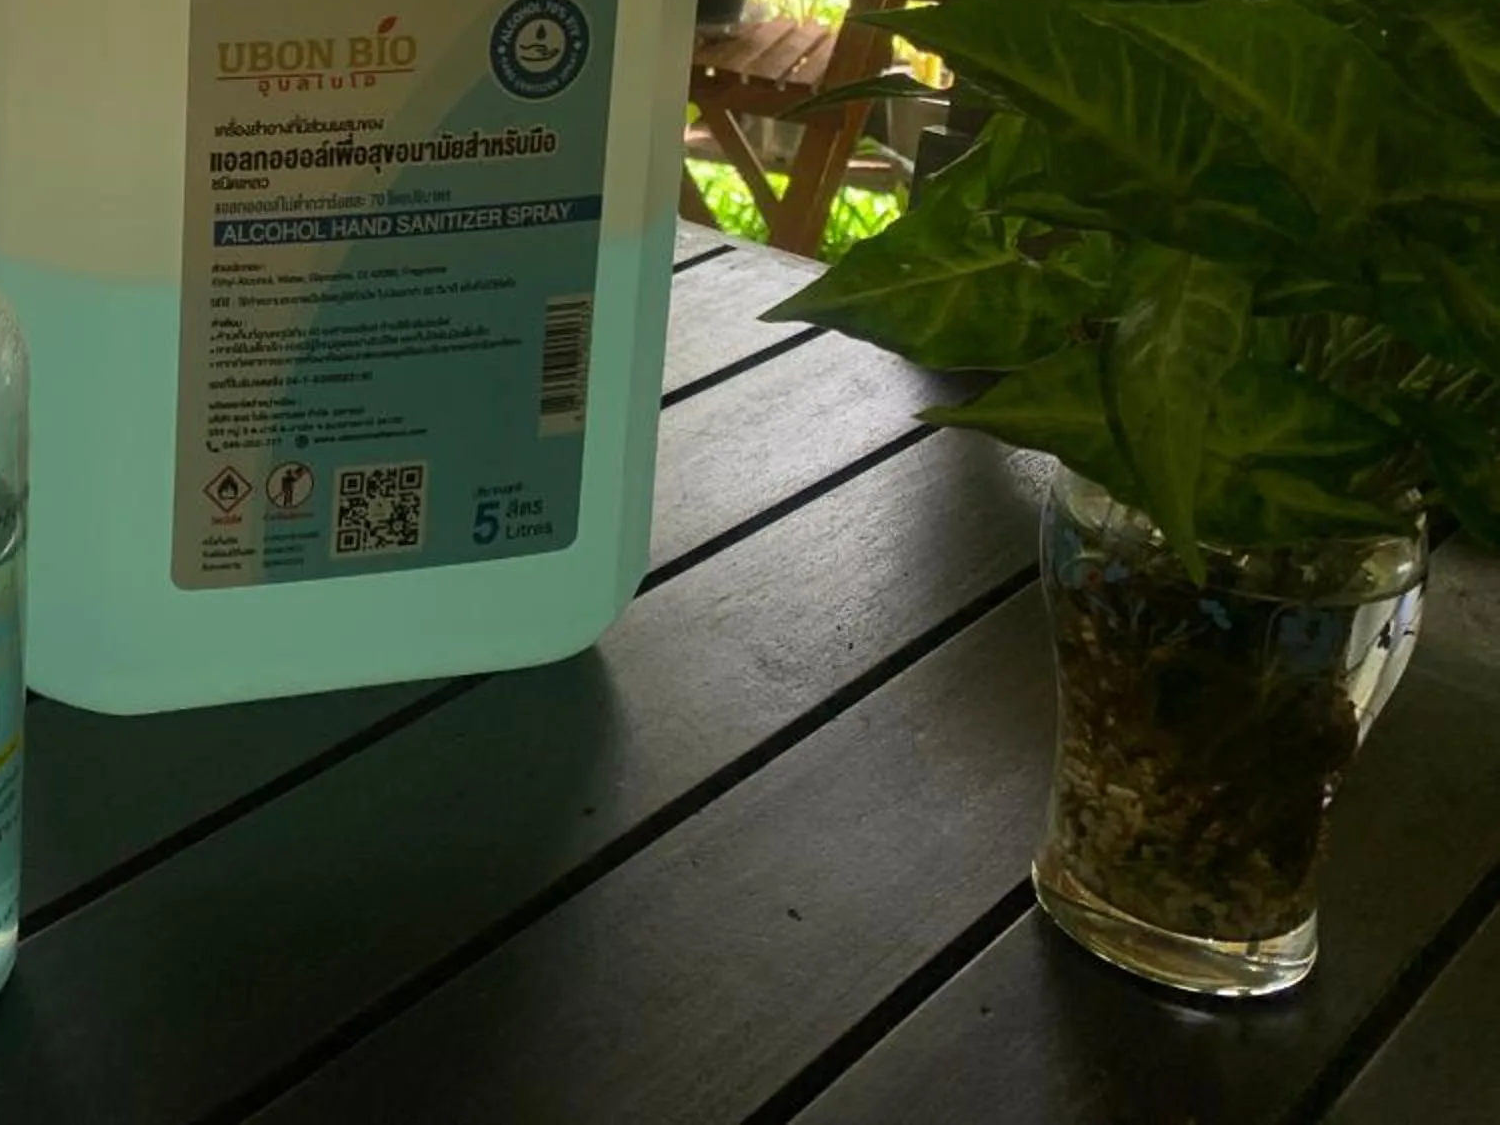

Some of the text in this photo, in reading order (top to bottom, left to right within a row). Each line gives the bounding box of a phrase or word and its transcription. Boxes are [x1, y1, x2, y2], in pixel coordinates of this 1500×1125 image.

[217, 33, 417, 74] UBON BIO
[210, 127, 557, 174] แอลกอฮอล์เพื่อสุขอนามัยสำหรับมือ
[221, 202, 575, 246] ALCOHOL HAND SANITIZER SPRAY
[472, 499, 501, 546] 5
